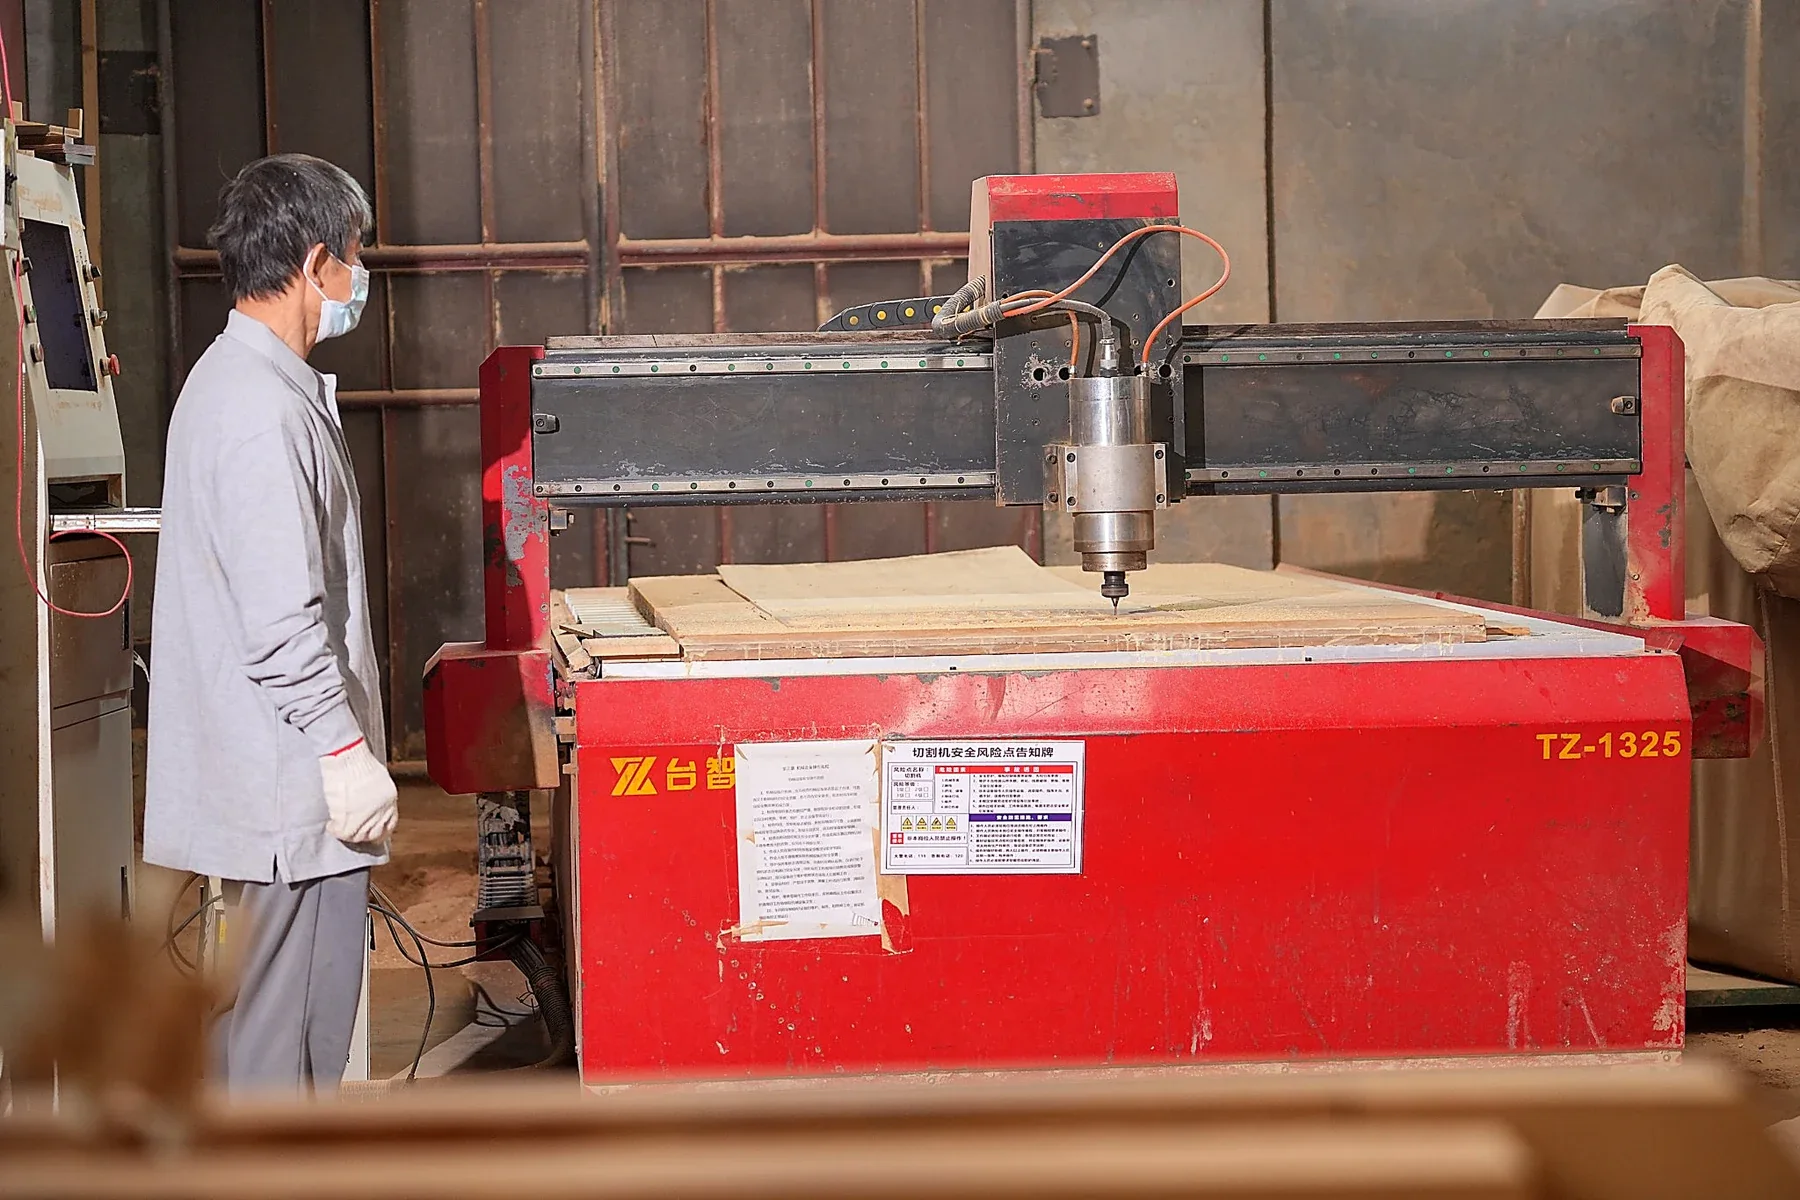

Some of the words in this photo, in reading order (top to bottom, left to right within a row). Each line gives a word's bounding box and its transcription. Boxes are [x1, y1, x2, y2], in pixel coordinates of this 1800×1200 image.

[912, 746, 1054, 758] 切割机安全风险点告知牌
[1536, 731, 1681, 760] TZ-1325
[666, 756, 735, 790] 台智
